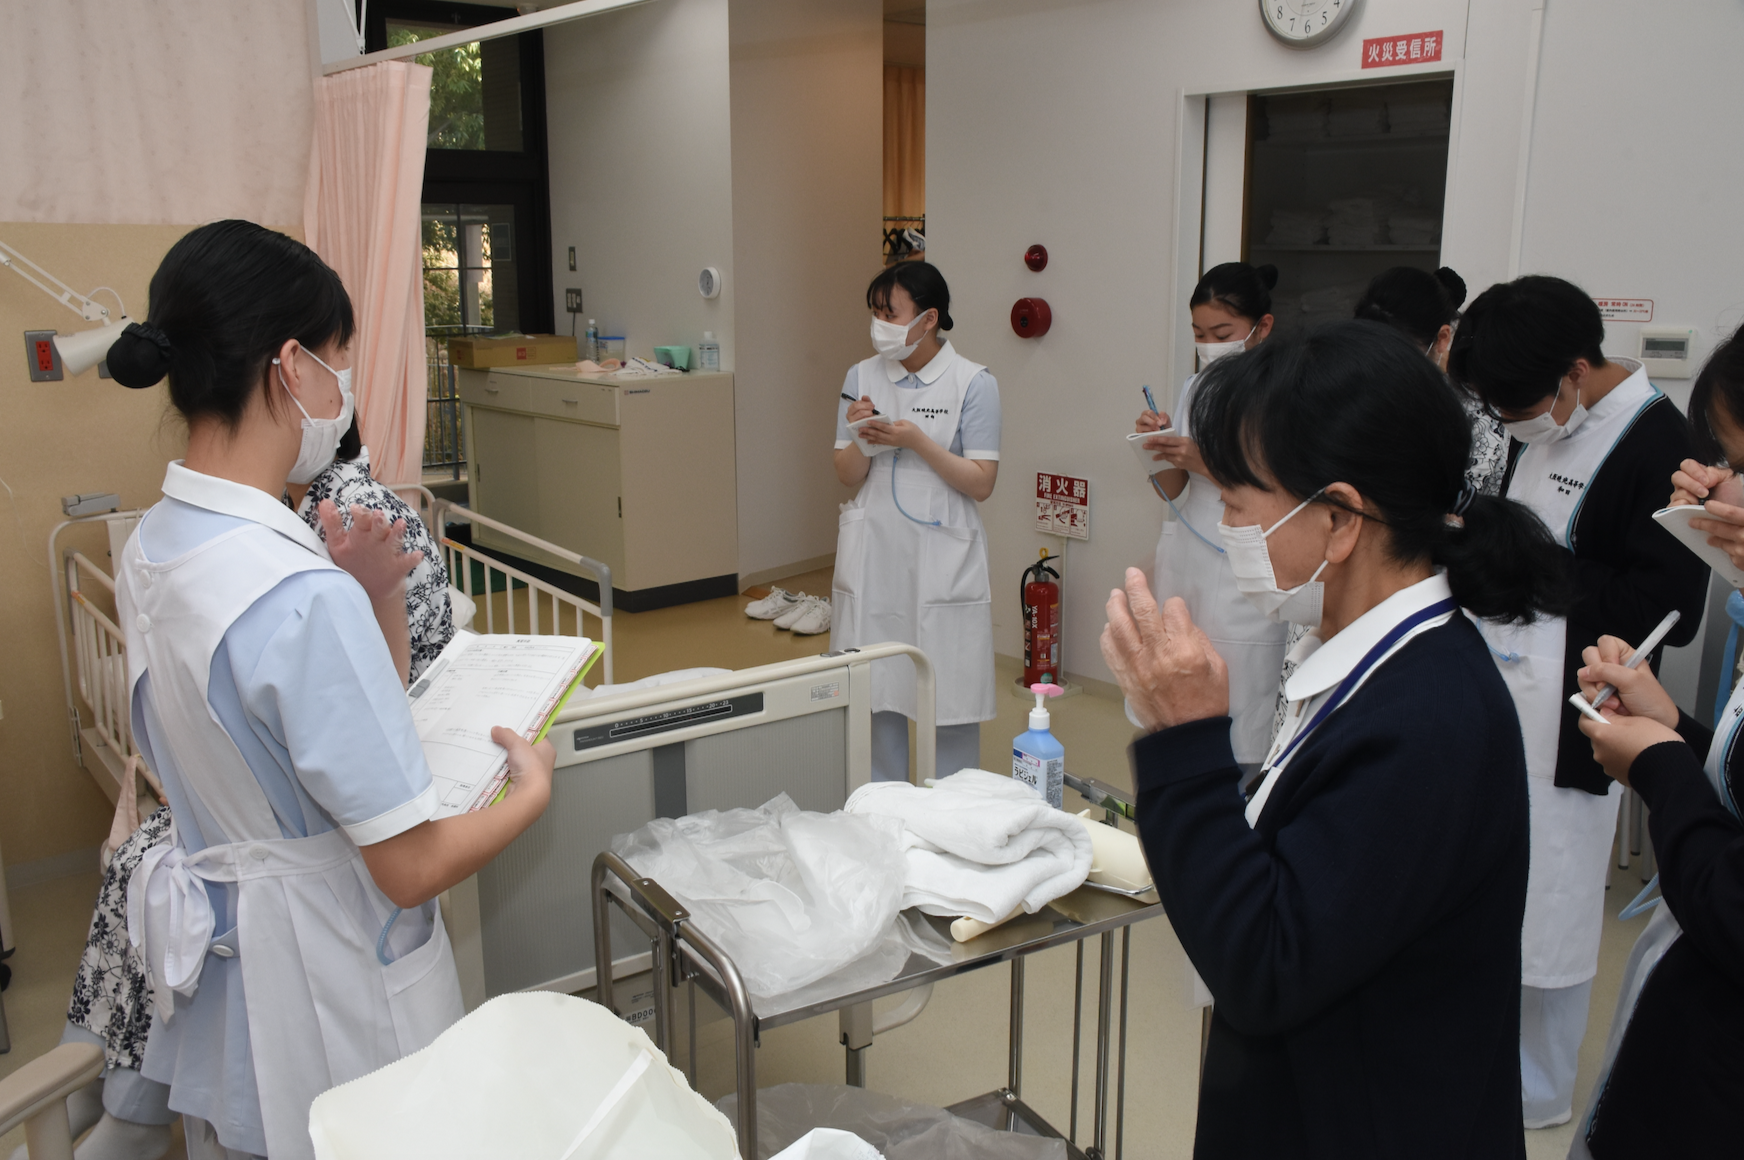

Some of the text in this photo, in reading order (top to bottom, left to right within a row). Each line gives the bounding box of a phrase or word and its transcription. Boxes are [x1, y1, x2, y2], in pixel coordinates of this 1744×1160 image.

[1277, 5, 1283, 19] 8
[1321, 11, 1327, 25] 5
[1290, 18, 1295, 31] 7
[1304, 19, 1311, 34] 6
[1368, 37, 1437, 63] 火災受信所
[1038, 474, 1086, 499] 消火器
[1014, 766, 1037, 785] ラビジェル
